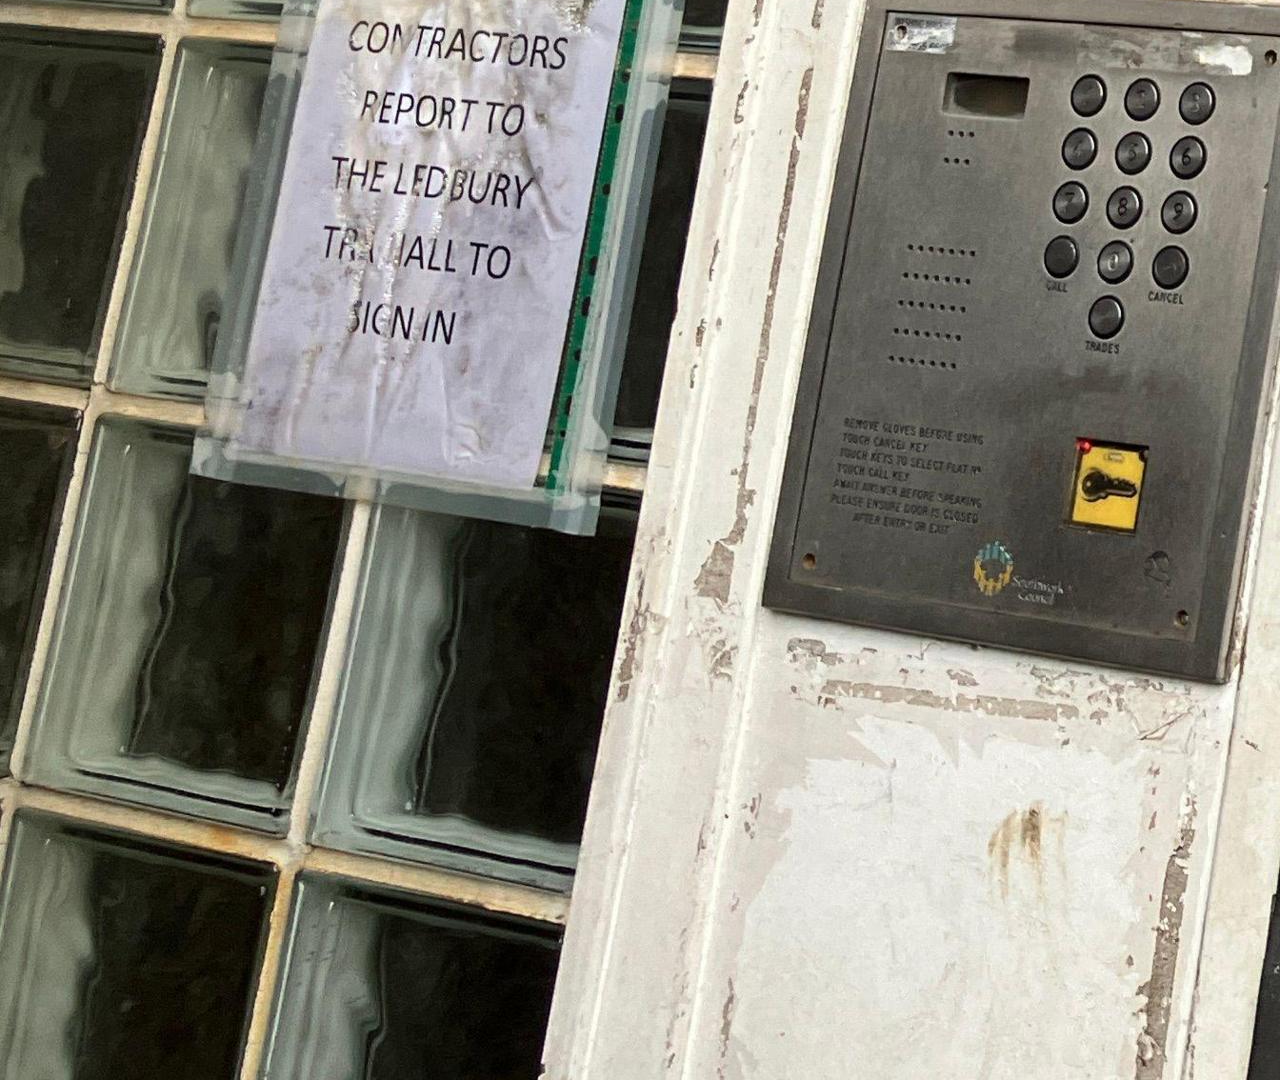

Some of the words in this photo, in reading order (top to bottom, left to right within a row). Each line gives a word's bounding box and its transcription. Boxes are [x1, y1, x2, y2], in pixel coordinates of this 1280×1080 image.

[361, 90, 479, 131] REPORT
[487, 101, 525, 136] TO
[332, 156, 387, 193] THE
[470, 242, 511, 279] TO
[1148, 291, 1184, 305] CANCEL
[421, 310, 456, 345] IN
[1085, 341, 1120, 354] TRADES
